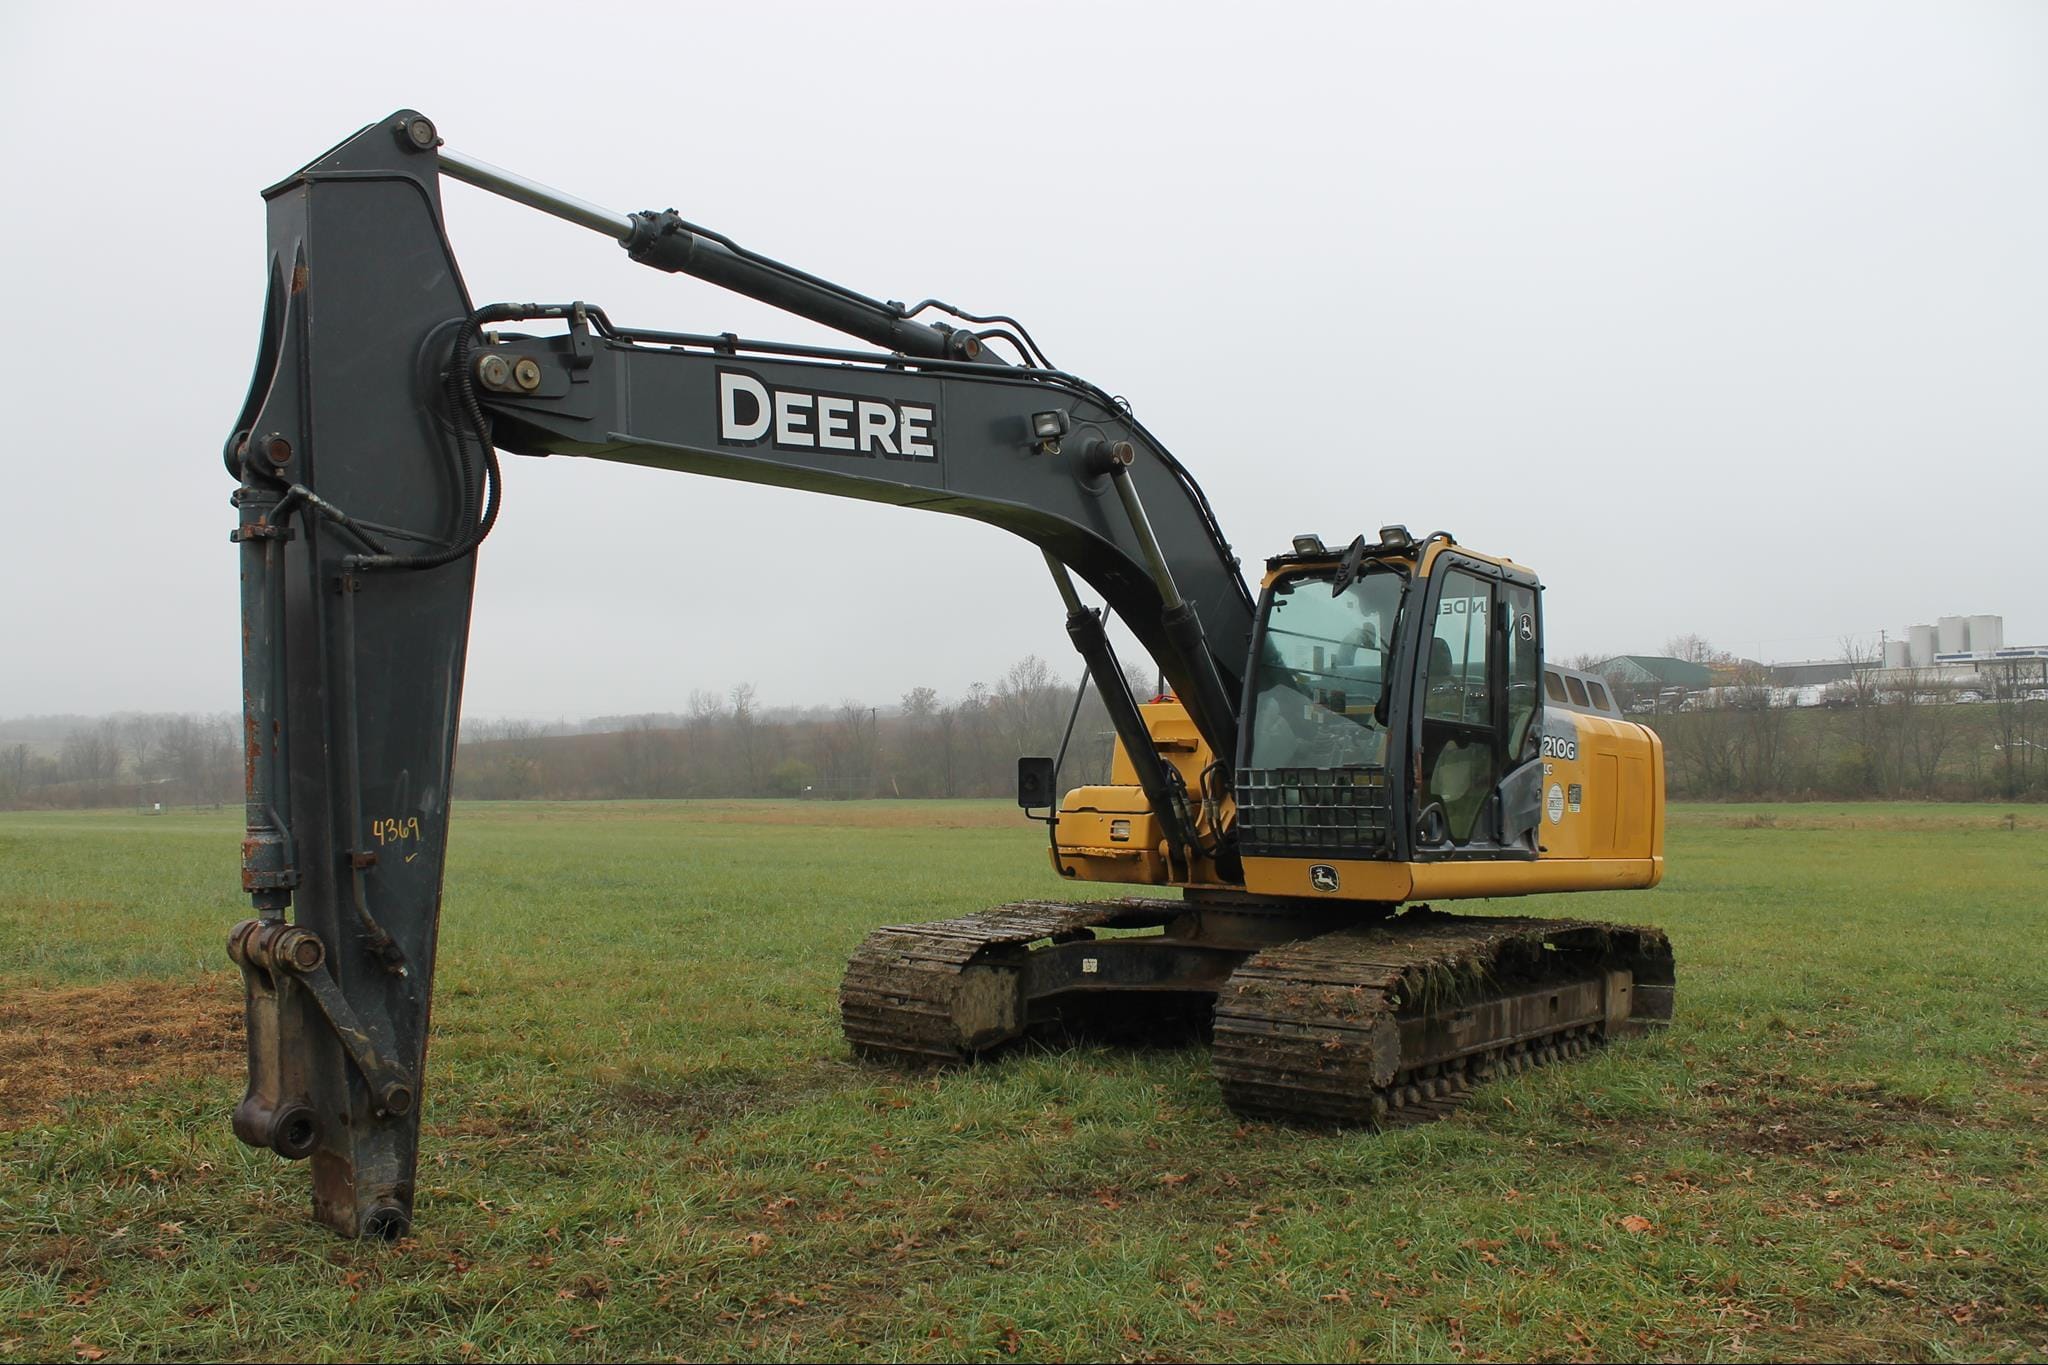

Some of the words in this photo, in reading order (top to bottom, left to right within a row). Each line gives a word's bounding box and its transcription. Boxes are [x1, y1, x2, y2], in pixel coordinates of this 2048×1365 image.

[720, 372, 934, 457] DEERE
[1543, 735, 1575, 760] 210G
[373, 817, 420, 846] 4369
